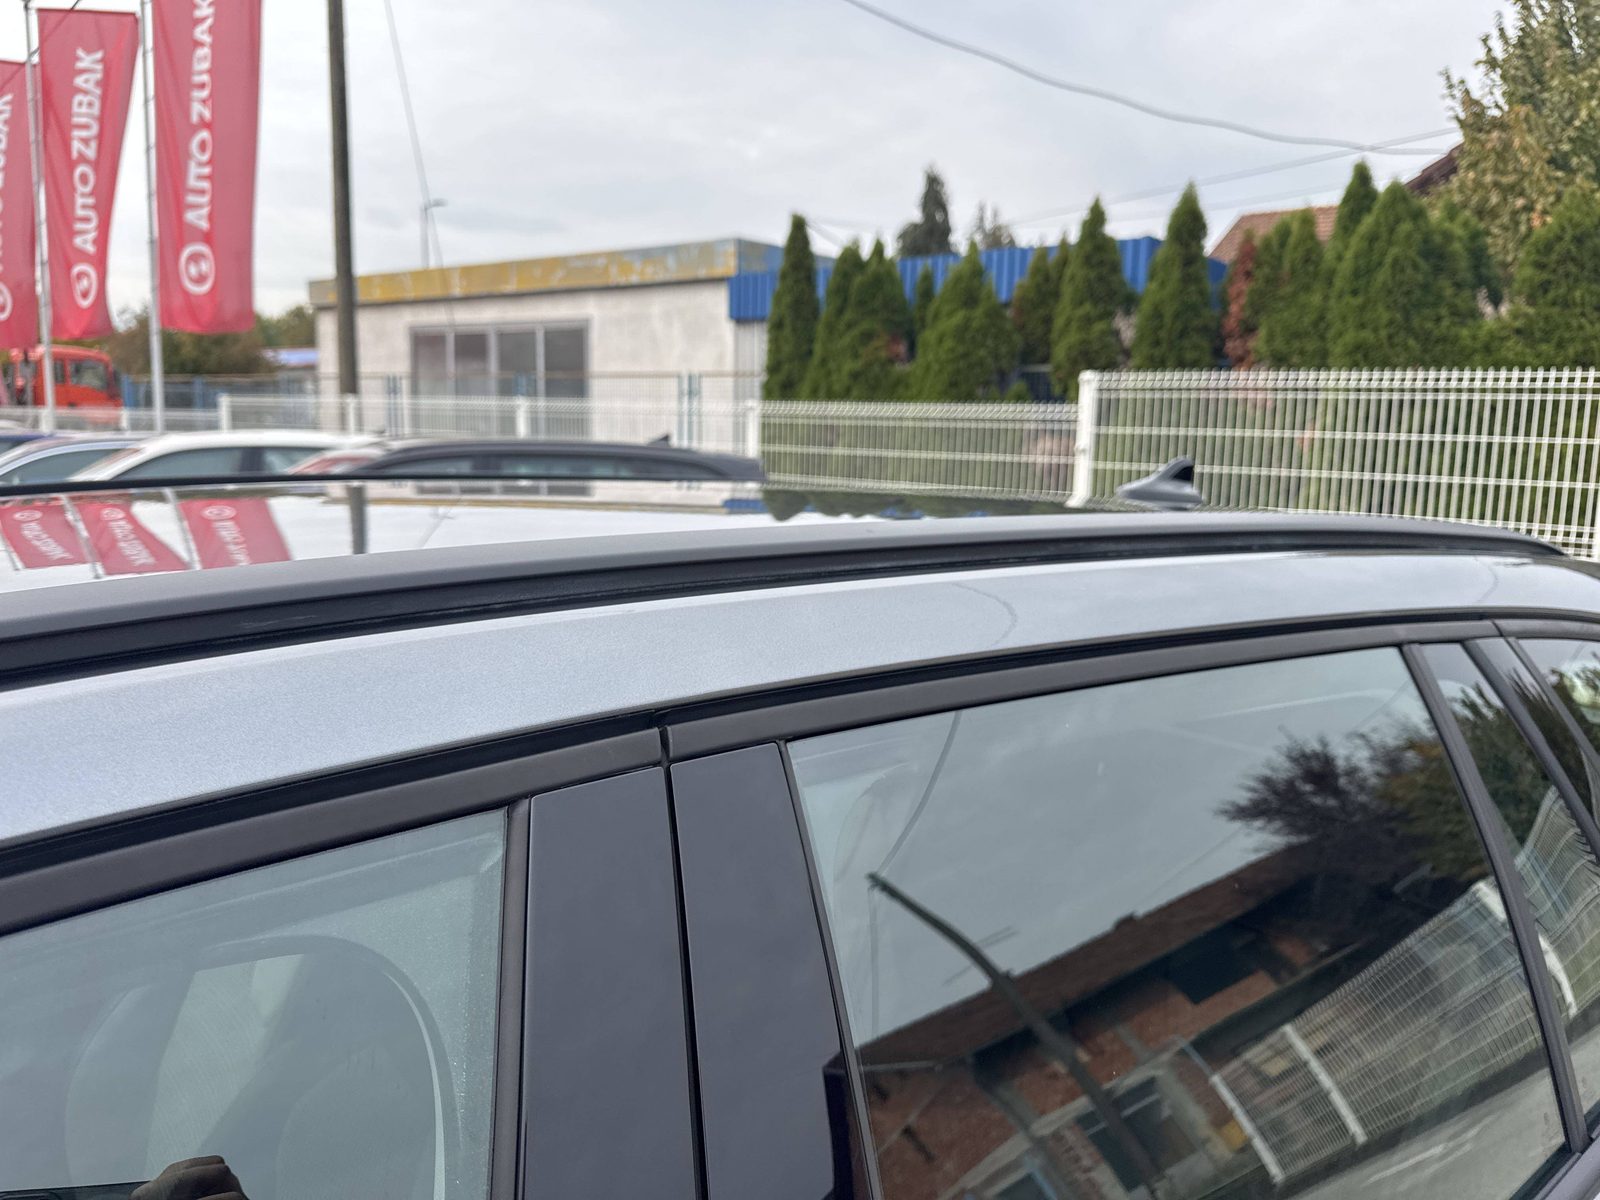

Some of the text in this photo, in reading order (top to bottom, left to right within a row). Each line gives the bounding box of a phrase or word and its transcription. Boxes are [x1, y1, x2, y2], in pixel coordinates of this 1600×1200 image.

[70, 47, 104, 255] AUTO ZUBAK
[183, 130, 213, 231] AUTO
